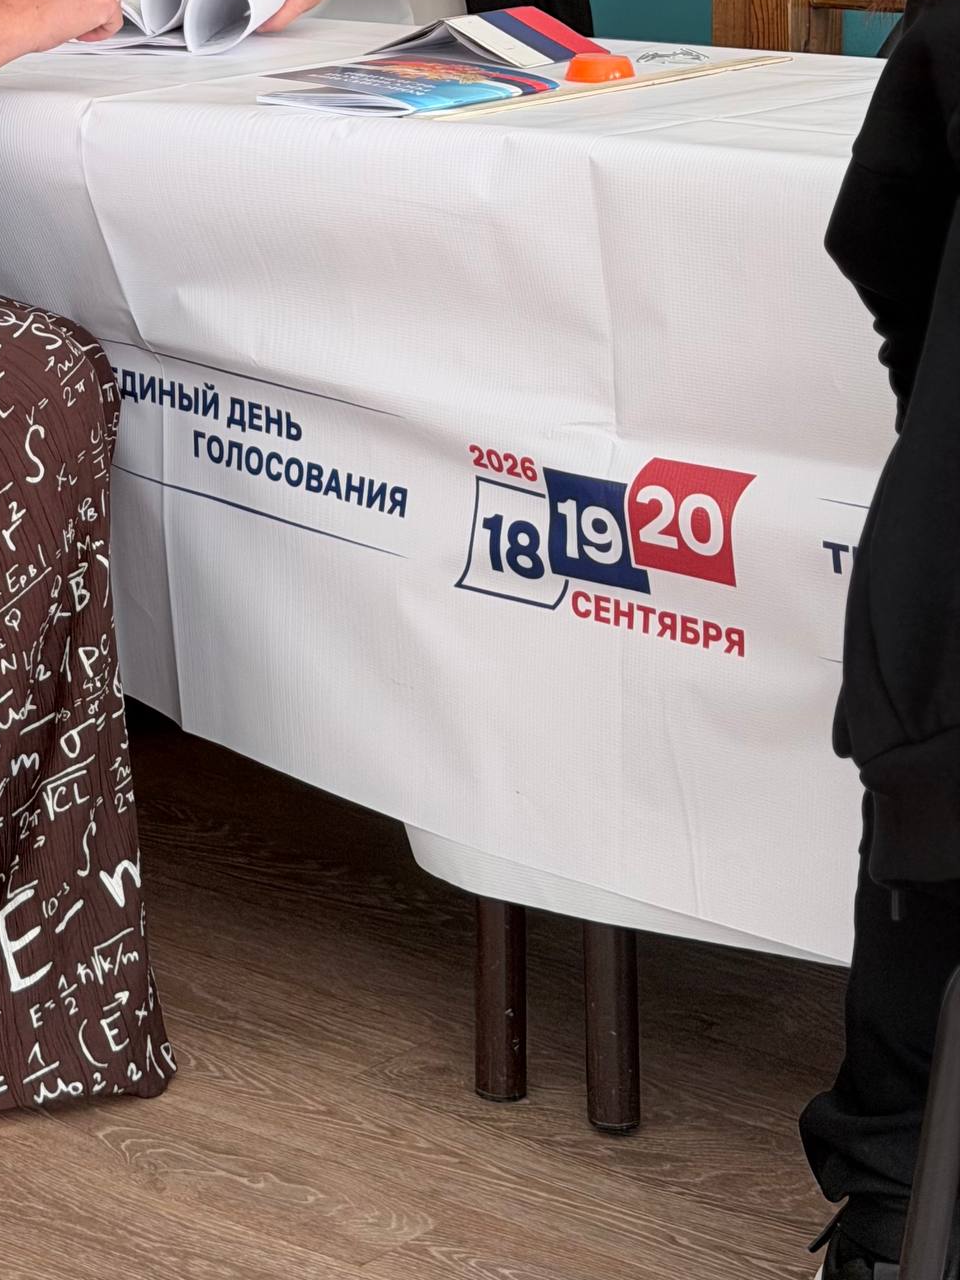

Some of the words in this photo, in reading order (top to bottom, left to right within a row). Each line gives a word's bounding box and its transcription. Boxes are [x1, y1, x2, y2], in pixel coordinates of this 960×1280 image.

[112, 367, 219, 420] ДИНЫЙ
[227, 396, 303, 441] ДЕНЬ
[193, 430, 409, 518] ГОЛОСОВАНИЯ
[469, 444, 538, 482] 2026
[482, 513, 545, 580] 18
[557, 498, 623, 565] 19
[636, 484, 724, 557] 20
[822, 540, 859, 575] Т
[571, 590, 746, 658] СЕНТЯБРЯ
